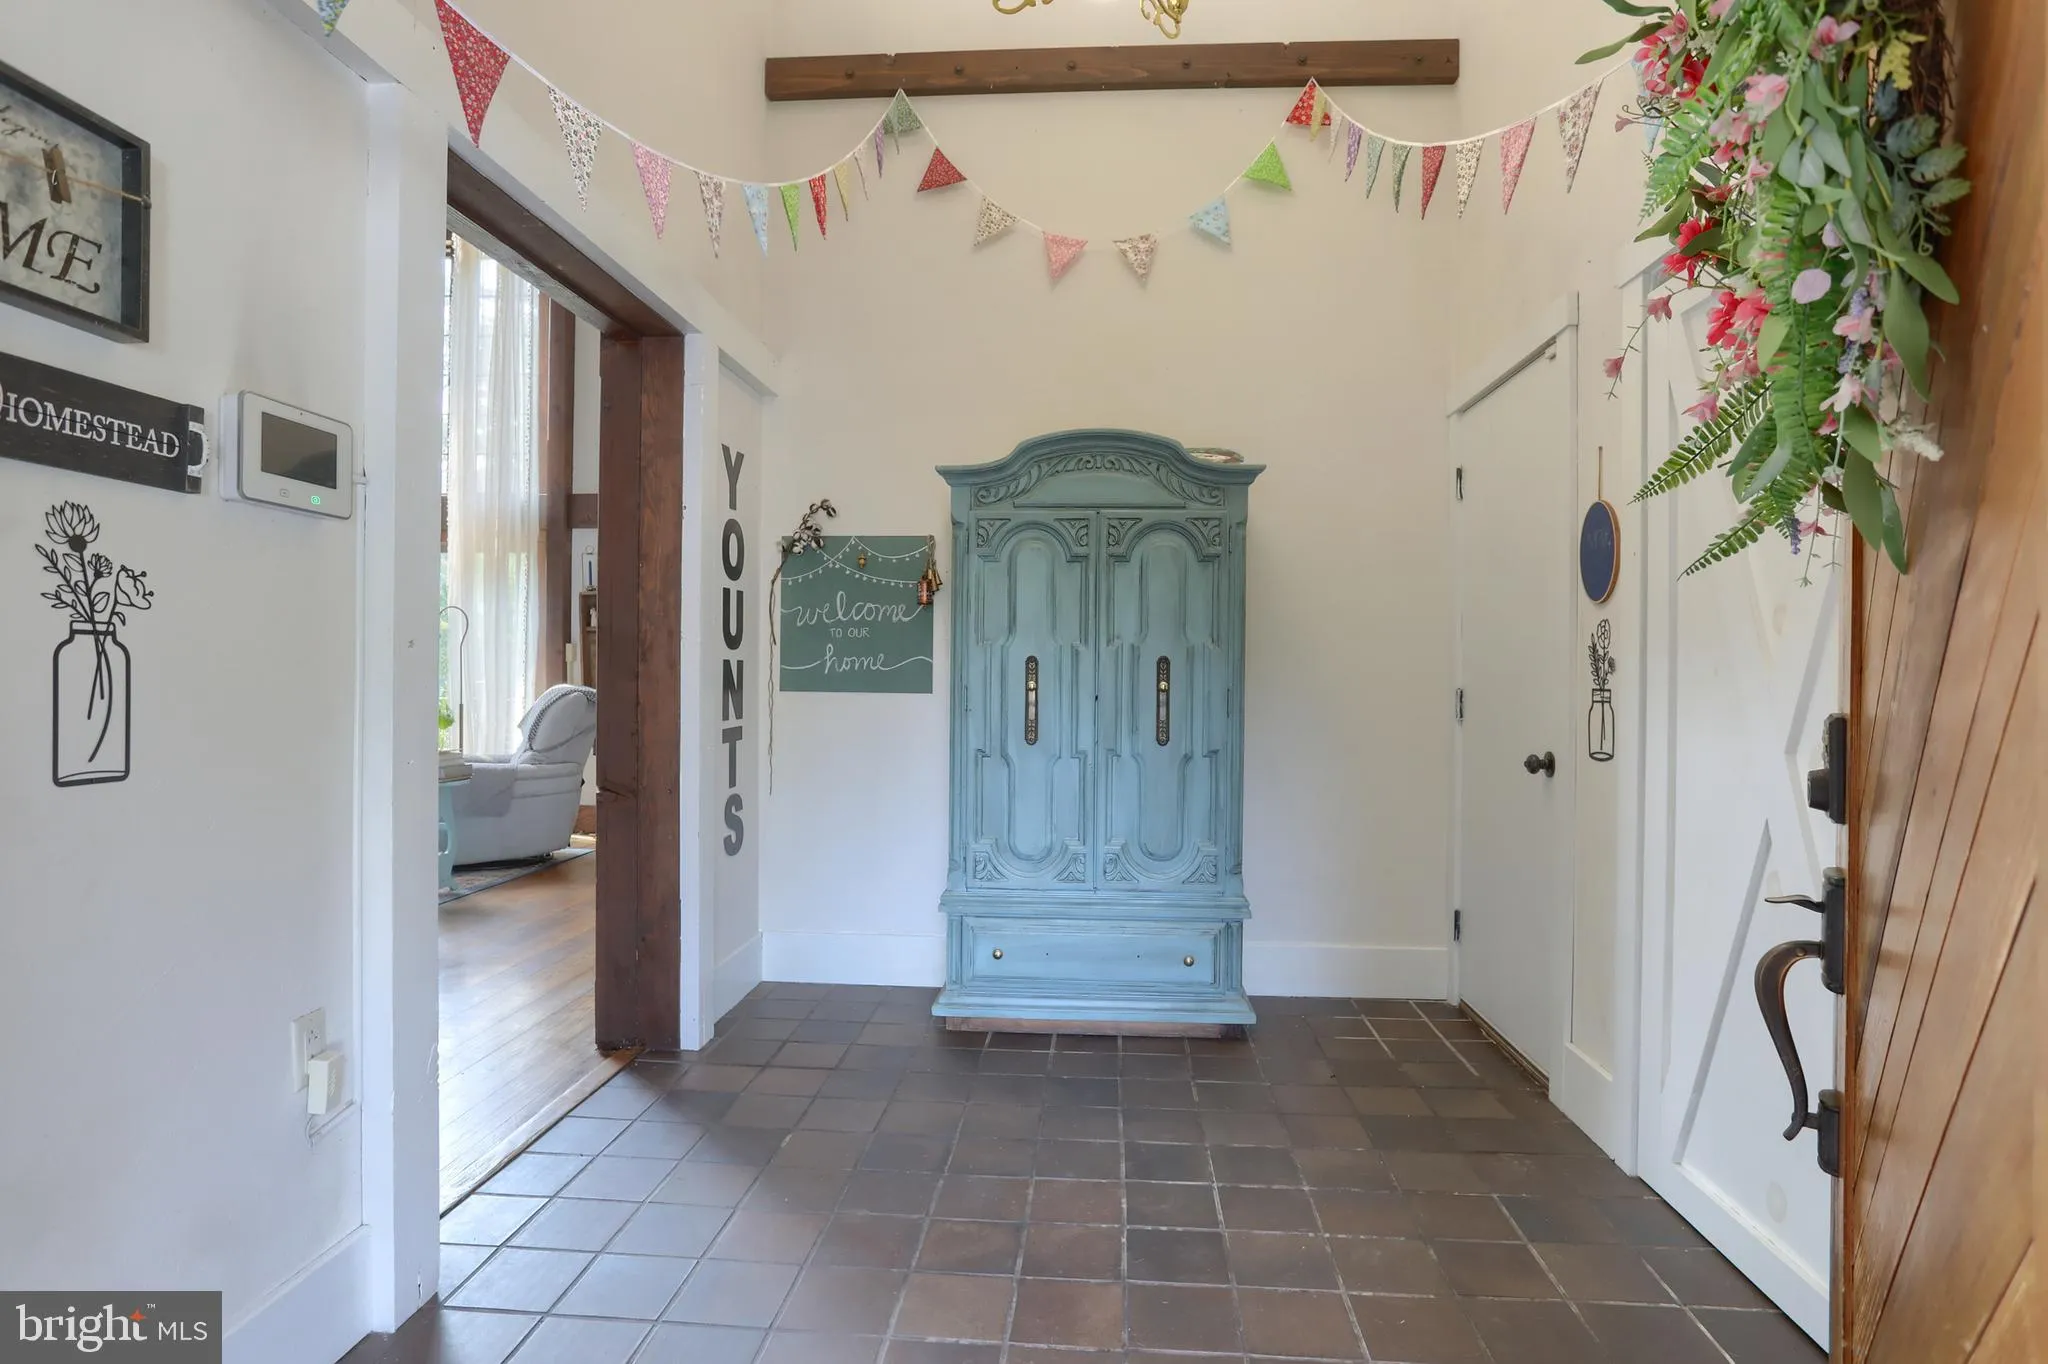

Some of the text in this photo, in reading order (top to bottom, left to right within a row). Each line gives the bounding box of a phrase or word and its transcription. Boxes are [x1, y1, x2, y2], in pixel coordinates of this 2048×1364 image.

[795, 591, 914, 626] welcome
[829, 627, 870, 639] TO OUR
[721, 444, 745, 856] YOUNTS
[824, 643, 889, 674] home
